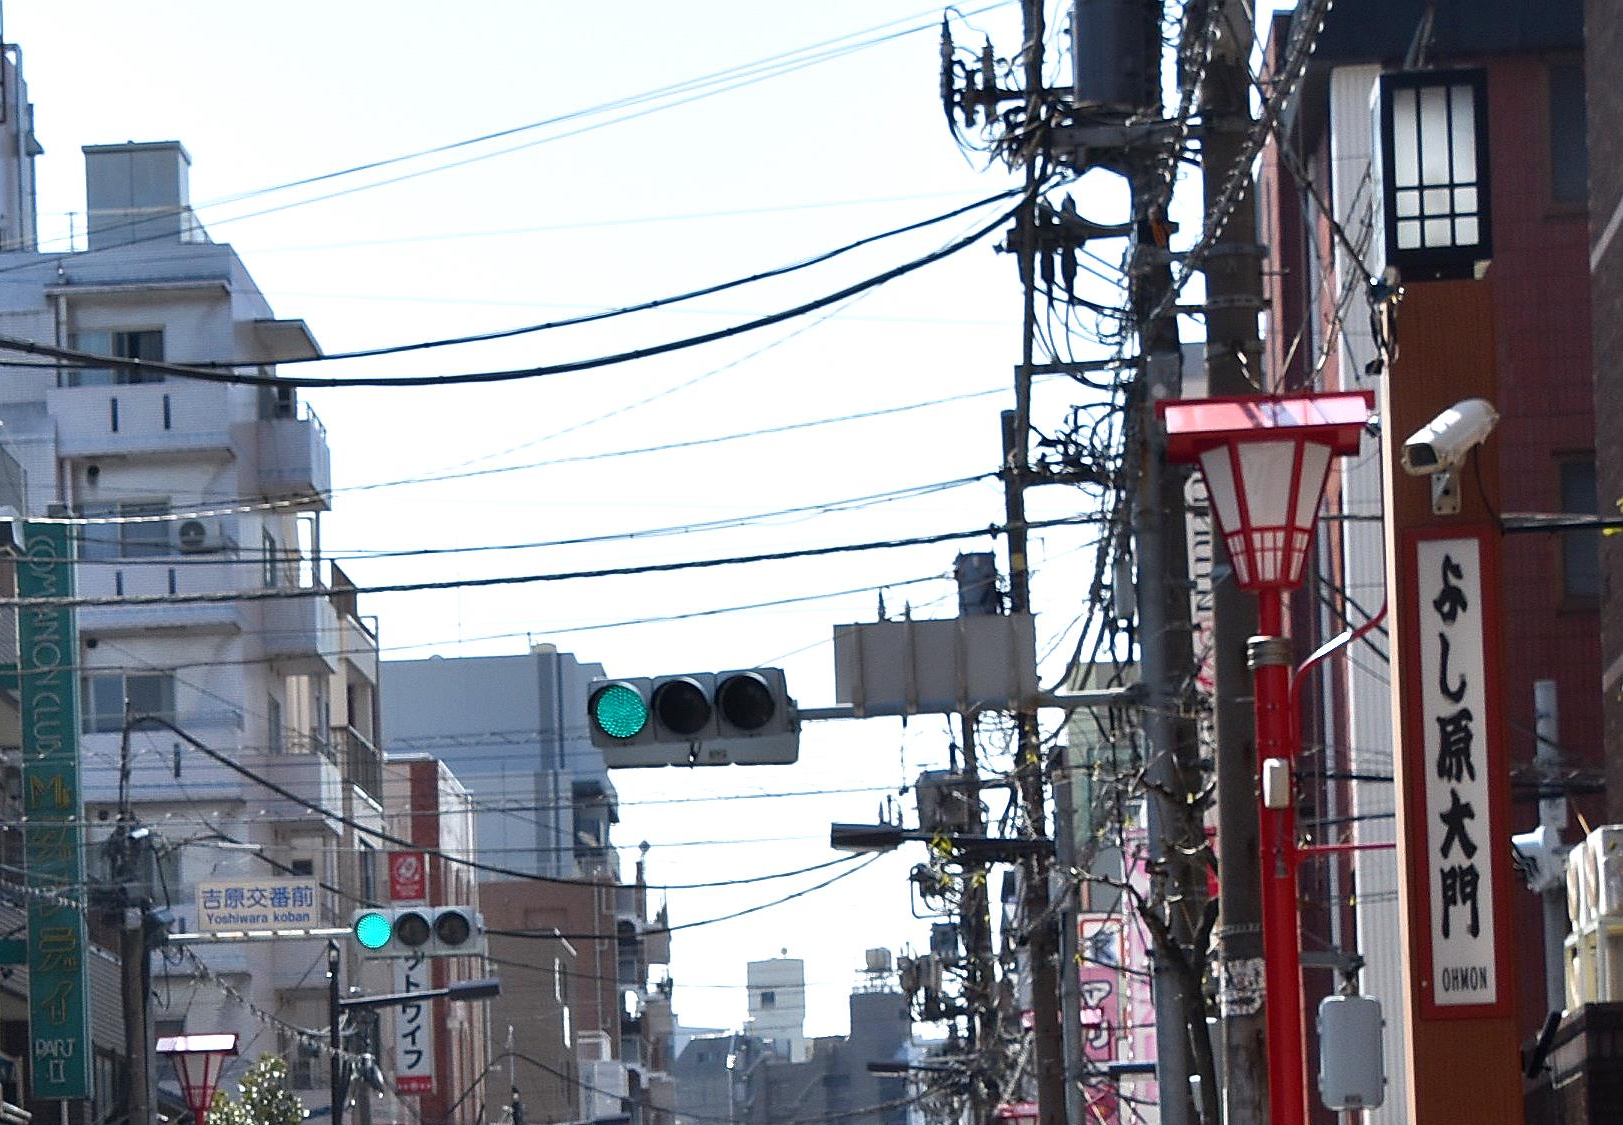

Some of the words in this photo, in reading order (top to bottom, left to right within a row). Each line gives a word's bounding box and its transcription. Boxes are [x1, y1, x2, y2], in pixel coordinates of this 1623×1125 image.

[1432, 554, 1480, 941] よし原大門
[202, 886, 314, 910] 吉原交番前
[206, 912, 268, 925] Yoshiwara
[273, 911, 310, 922] koban
[1441, 965, 1488, 992] OHMON
